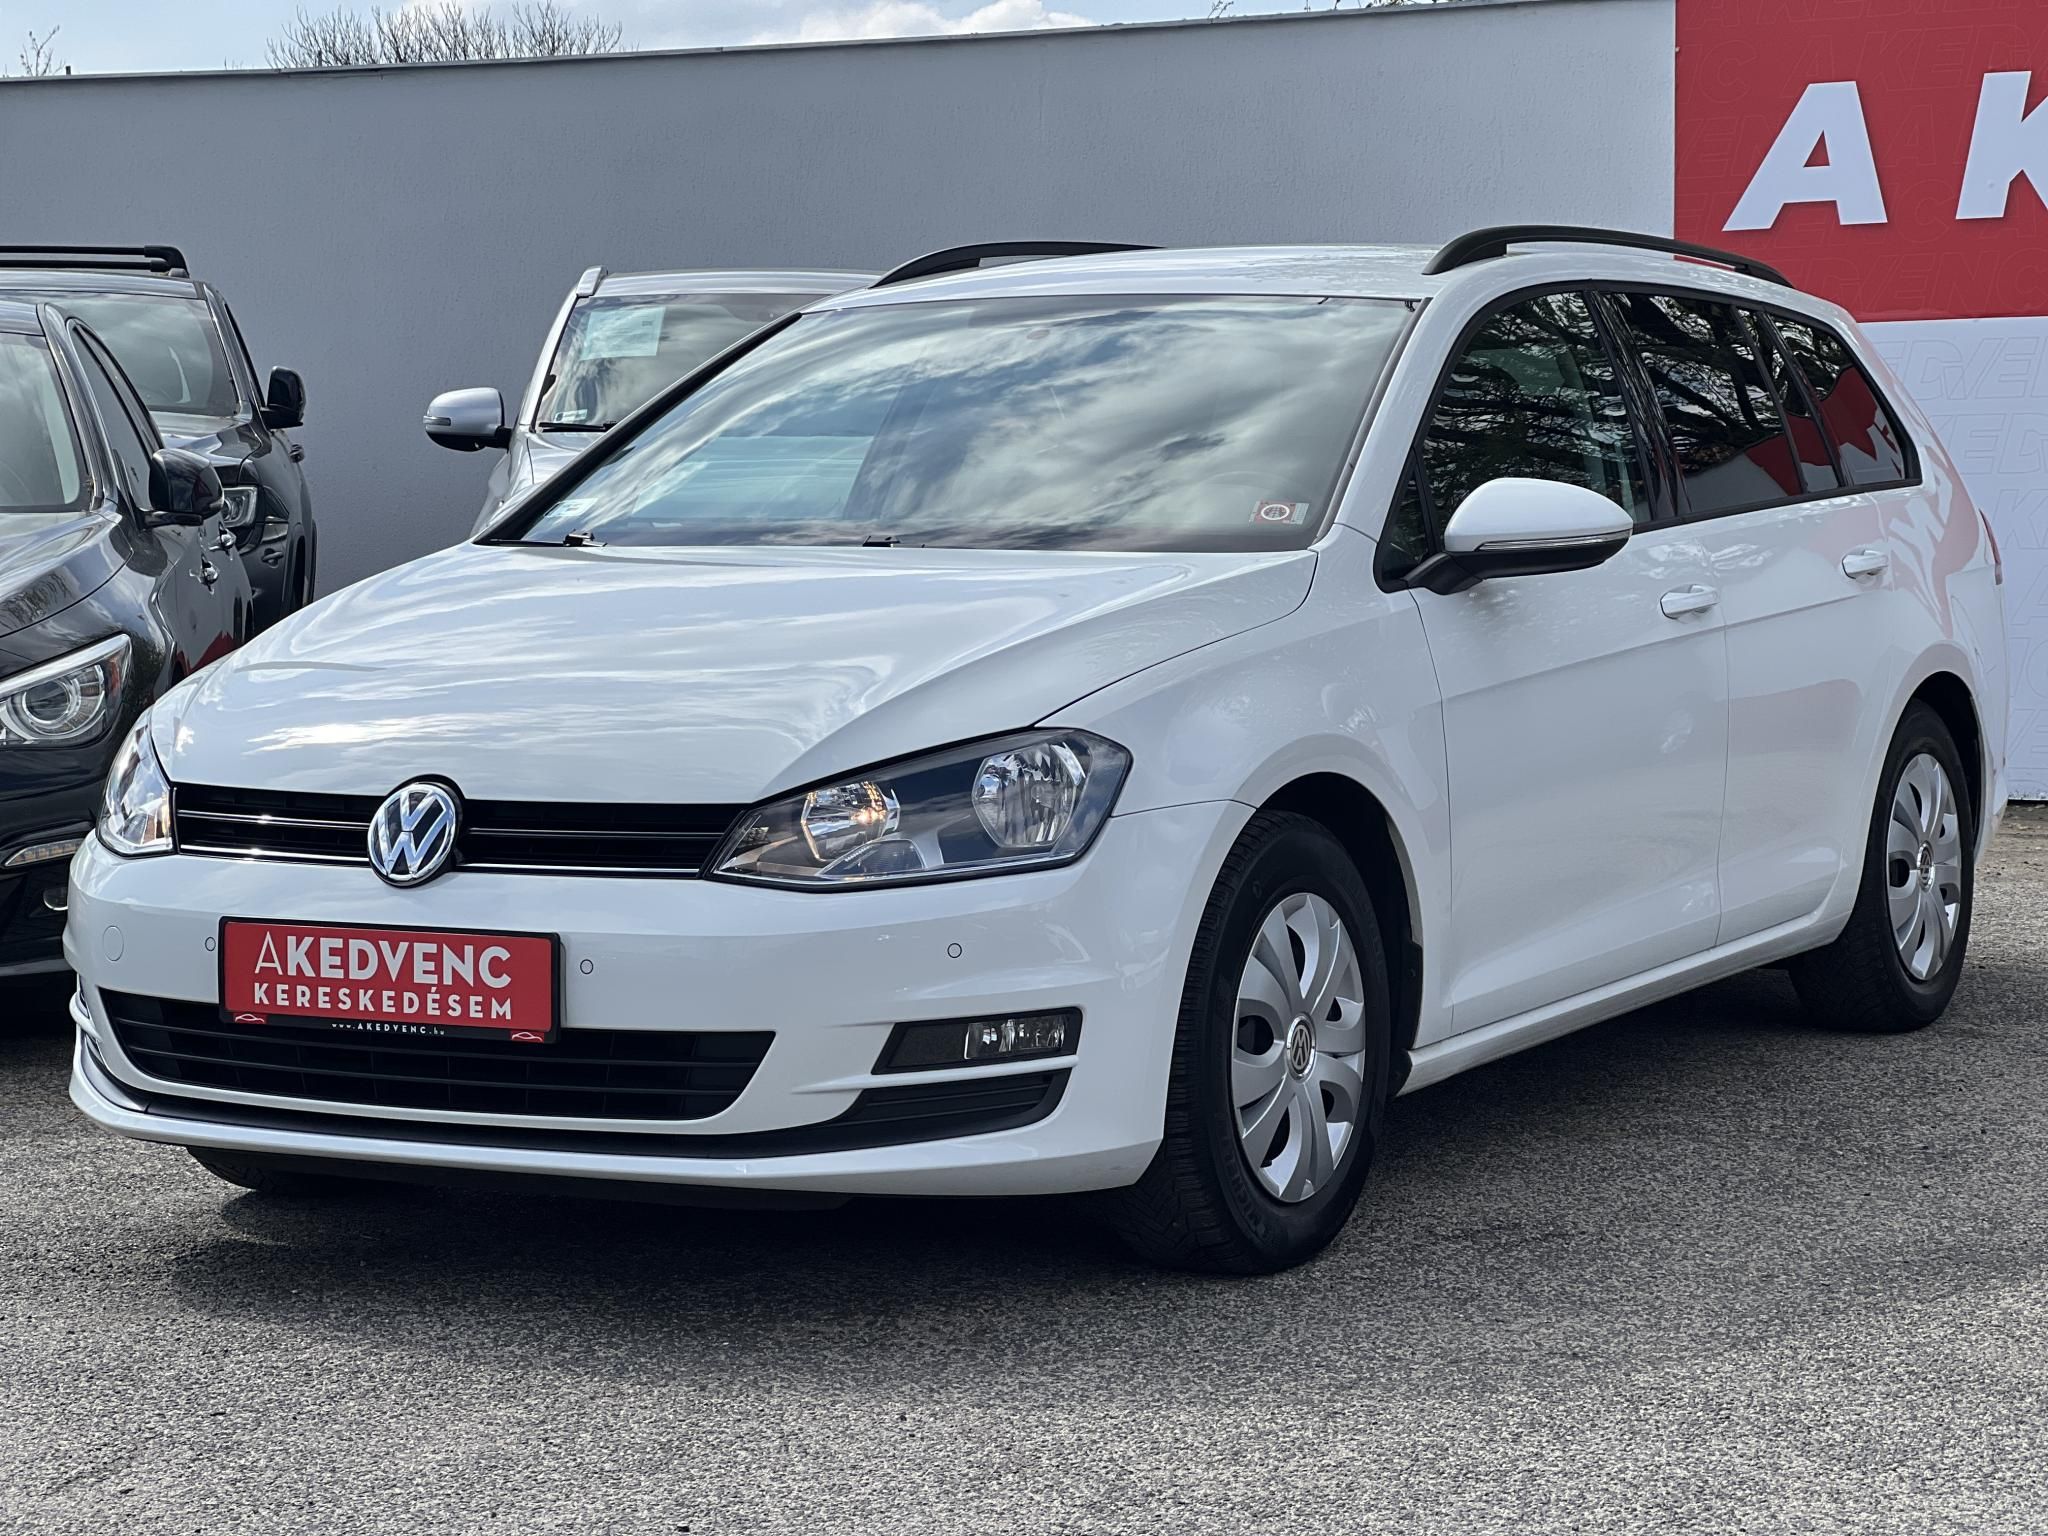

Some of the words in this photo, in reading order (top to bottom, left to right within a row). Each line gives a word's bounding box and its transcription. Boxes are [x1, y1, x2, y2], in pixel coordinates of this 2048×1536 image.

[1722, 80, 1888, 232] A
[253, 982, 512, 1020] KERESKEDÉSEM
[331, 1022, 445, 1036] www.AKEDVENC.hu
